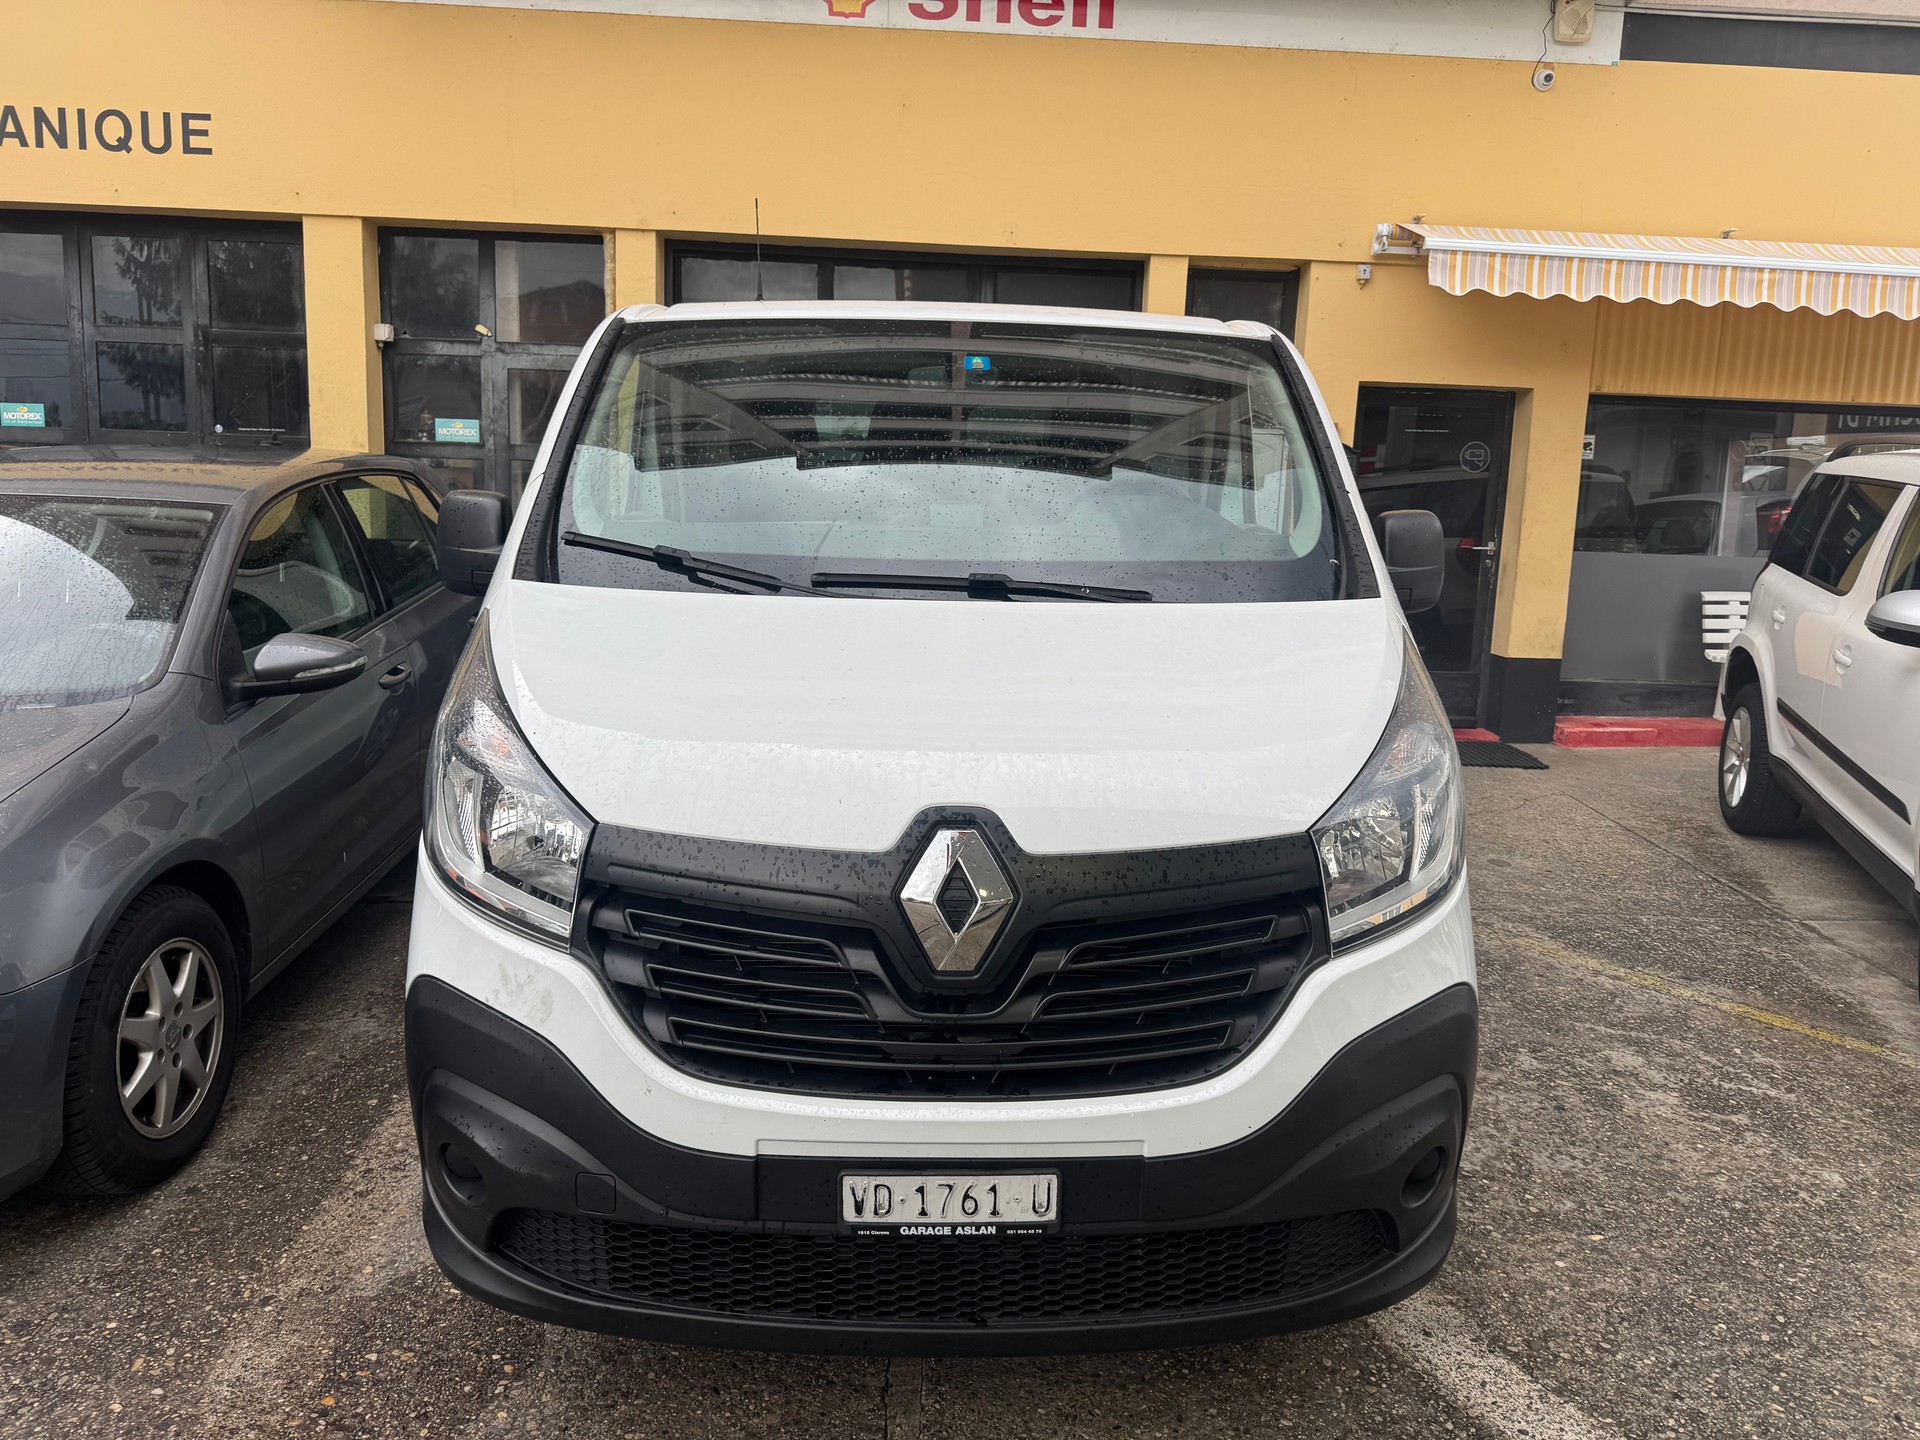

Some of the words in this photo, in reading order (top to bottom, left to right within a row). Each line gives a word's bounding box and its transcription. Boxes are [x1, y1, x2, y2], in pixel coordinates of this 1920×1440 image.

[0, 105, 213, 155] ANIQUE
[3, 411, 42, 420] MOTOREX
[438, 427, 477, 436] MOTOREX
[849, 1179, 894, 1218] VD
[914, 1181, 1002, 1218] 1761
[1031, 1178, 1052, 1217] U
[900, 1226, 951, 1235] GARAGE
[955, 1225, 996, 1235] ASLAN
